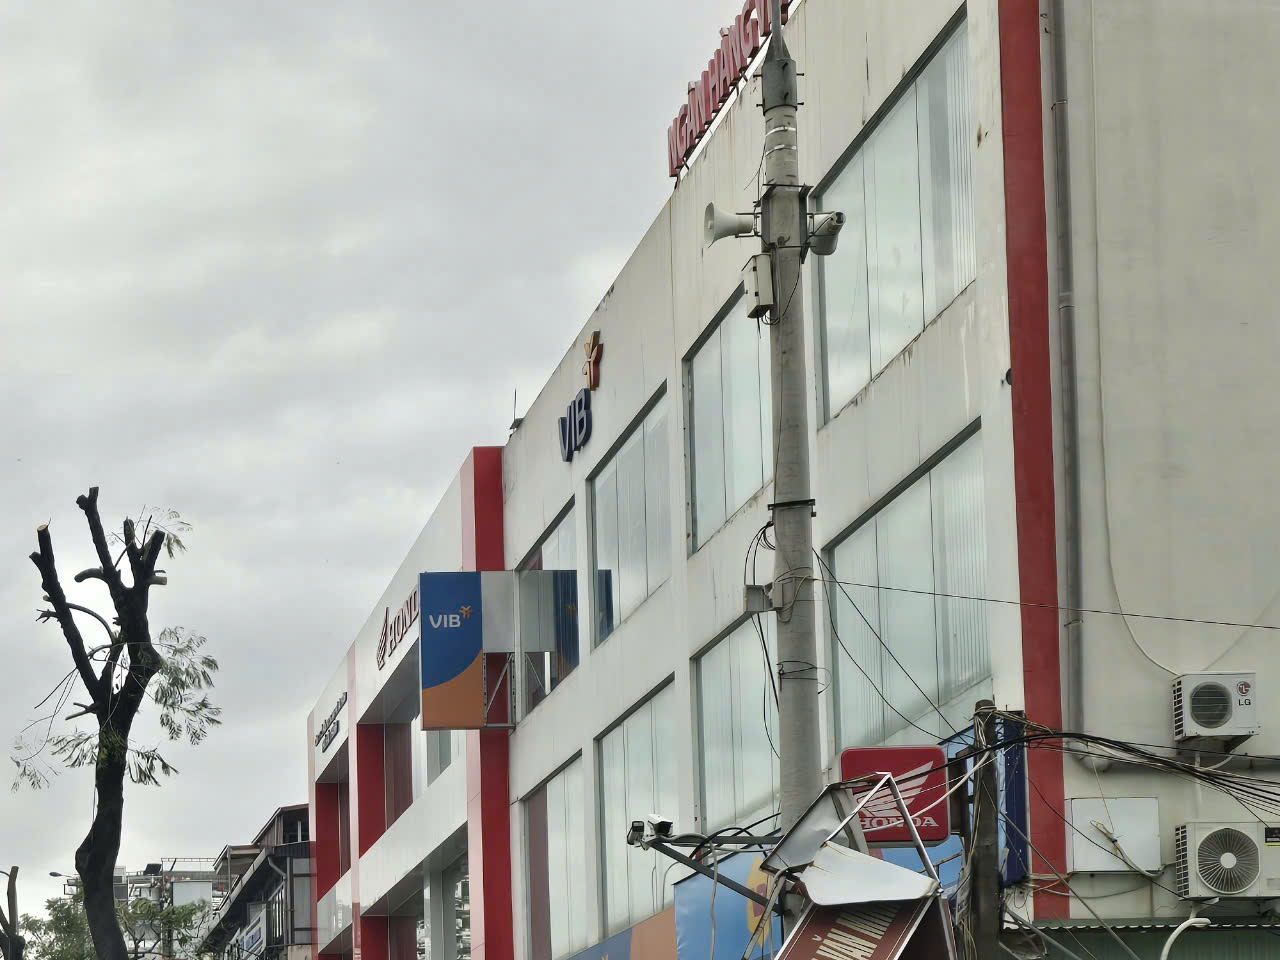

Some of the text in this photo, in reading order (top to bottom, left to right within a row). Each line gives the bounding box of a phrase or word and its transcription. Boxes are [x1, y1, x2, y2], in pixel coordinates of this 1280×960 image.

[558, 388, 592, 462] VIB
[429, 614, 461, 629] VIB
[1238, 698, 1252, 706] LG
